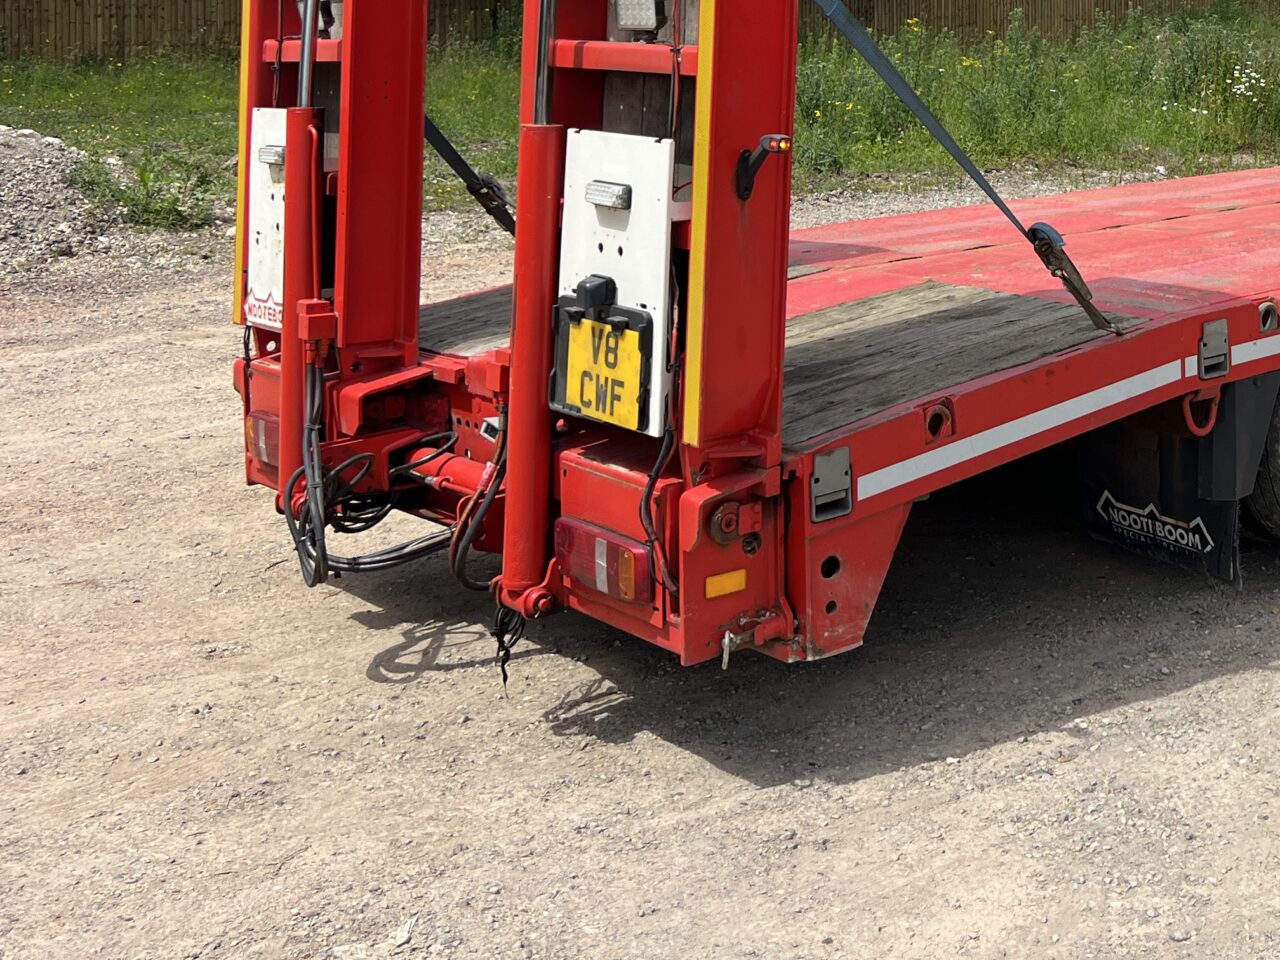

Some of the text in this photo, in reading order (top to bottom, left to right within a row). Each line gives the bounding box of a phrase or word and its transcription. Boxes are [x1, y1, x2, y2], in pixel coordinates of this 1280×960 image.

[247, 303, 282, 323] NOOTEBO
[591, 325, 619, 370] V8
[580, 370, 625, 417] CWF
